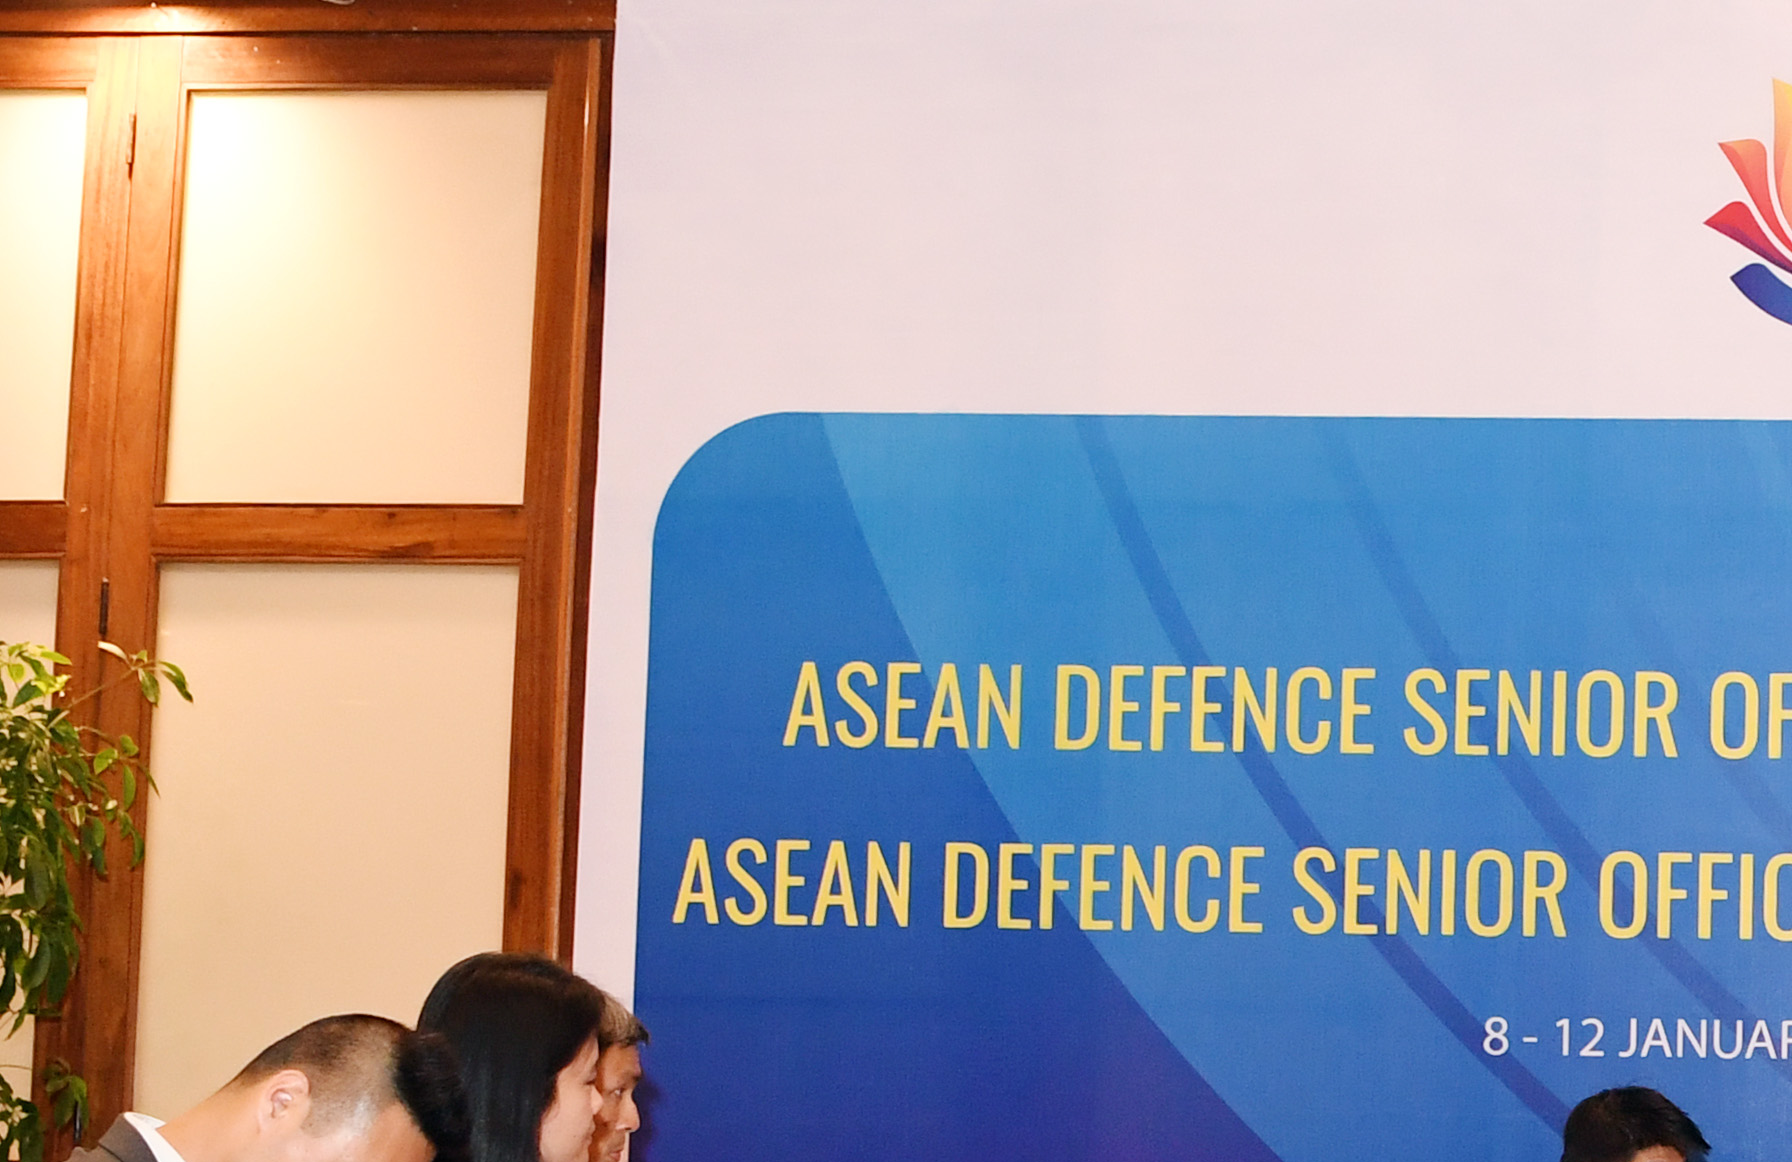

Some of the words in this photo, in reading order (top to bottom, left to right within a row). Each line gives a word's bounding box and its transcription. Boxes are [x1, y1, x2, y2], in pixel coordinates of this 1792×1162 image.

[783, 661, 1023, 750] ASEAN
[1053, 663, 1377, 755] DEFENCE
[1403, 668, 1679, 759] SENIOR
[672, 837, 912, 928] ASEAN
[943, 841, 1265, 933] DEFENCE
[1292, 846, 1567, 938] SENIOR
[1482, 1016, 1510, 1057] 8
[1555, 1017, 1605, 1058] 12
